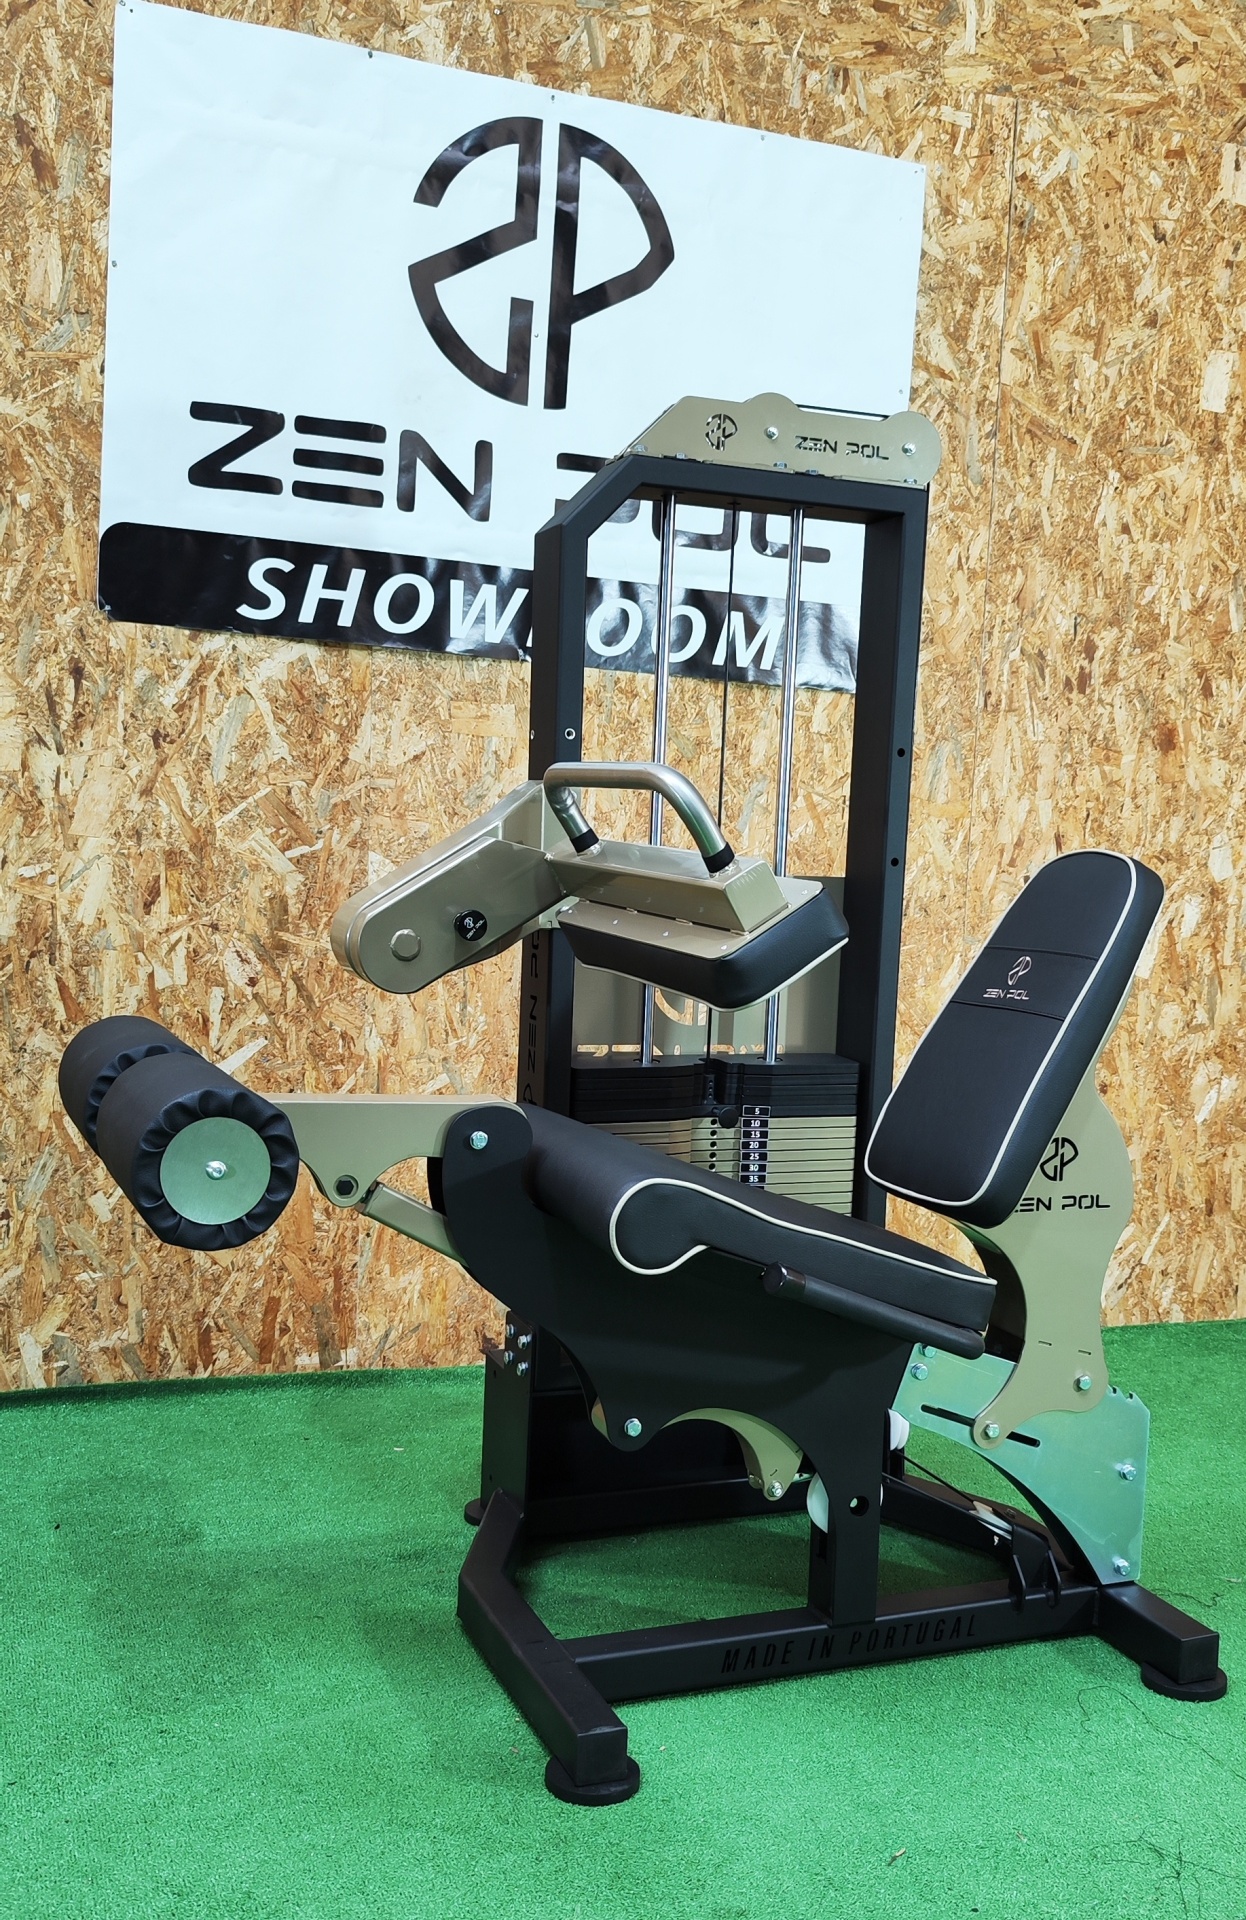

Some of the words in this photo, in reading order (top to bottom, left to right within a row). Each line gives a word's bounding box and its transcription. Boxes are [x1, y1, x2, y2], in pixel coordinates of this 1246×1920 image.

[188, 401, 493, 522] ZEN
[795, 434, 838, 454] ZEN
[845, 441, 890, 460] POL
[236, 557, 786, 671] SHOWOOM
[982, 988, 1007, 999] ZEN
[1006, 989, 1030, 1000] POL
[1014, 1196, 1052, 1213] EN
[1061, 1194, 1111, 1211] POL
[721, 1640, 795, 1674] MADE
[808, 1634, 836, 1661] IN
[849, 1613, 976, 1655] PORTUGAL
